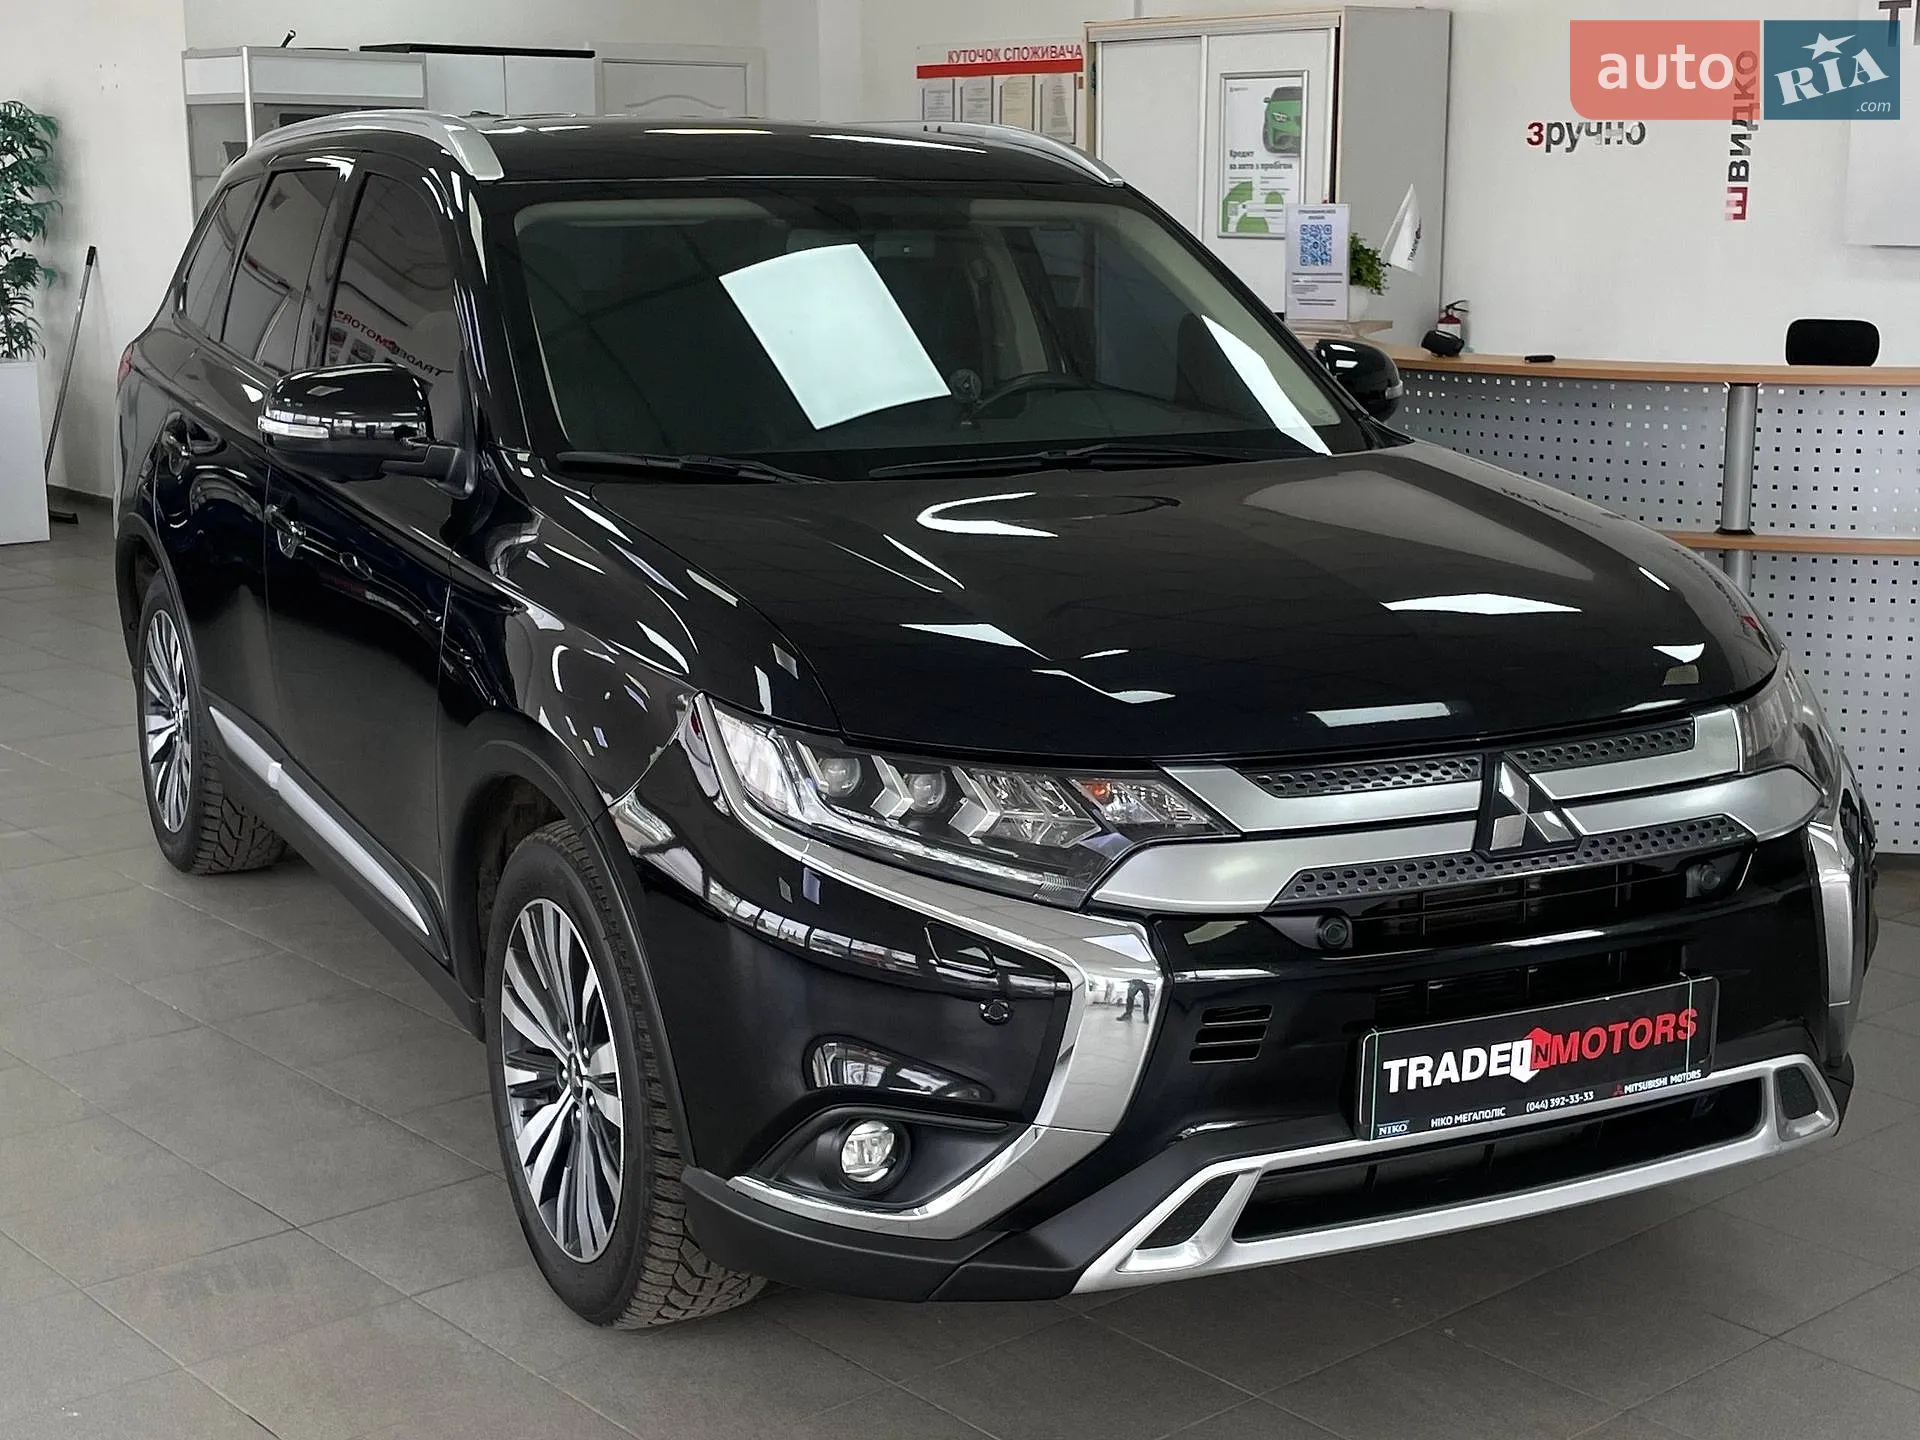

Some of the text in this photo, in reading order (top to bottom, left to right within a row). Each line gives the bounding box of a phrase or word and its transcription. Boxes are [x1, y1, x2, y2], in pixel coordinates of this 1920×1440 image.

[948, 44, 1083, 63] КУТОЧОК СПОЖИВАЧА
[1526, 120, 1646, 153] зручно
[1229, 150, 1254, 159] Кредит
[1624, 1068, 1702, 1095] MITSUBISHI MOTORS
[1526, 1090, 1594, 1113] (044) 392-33-33
[1430, 1106, 1506, 1129] НІКО МЕГАПОЛІС
[1379, 1123, 1409, 1136] NIKO
